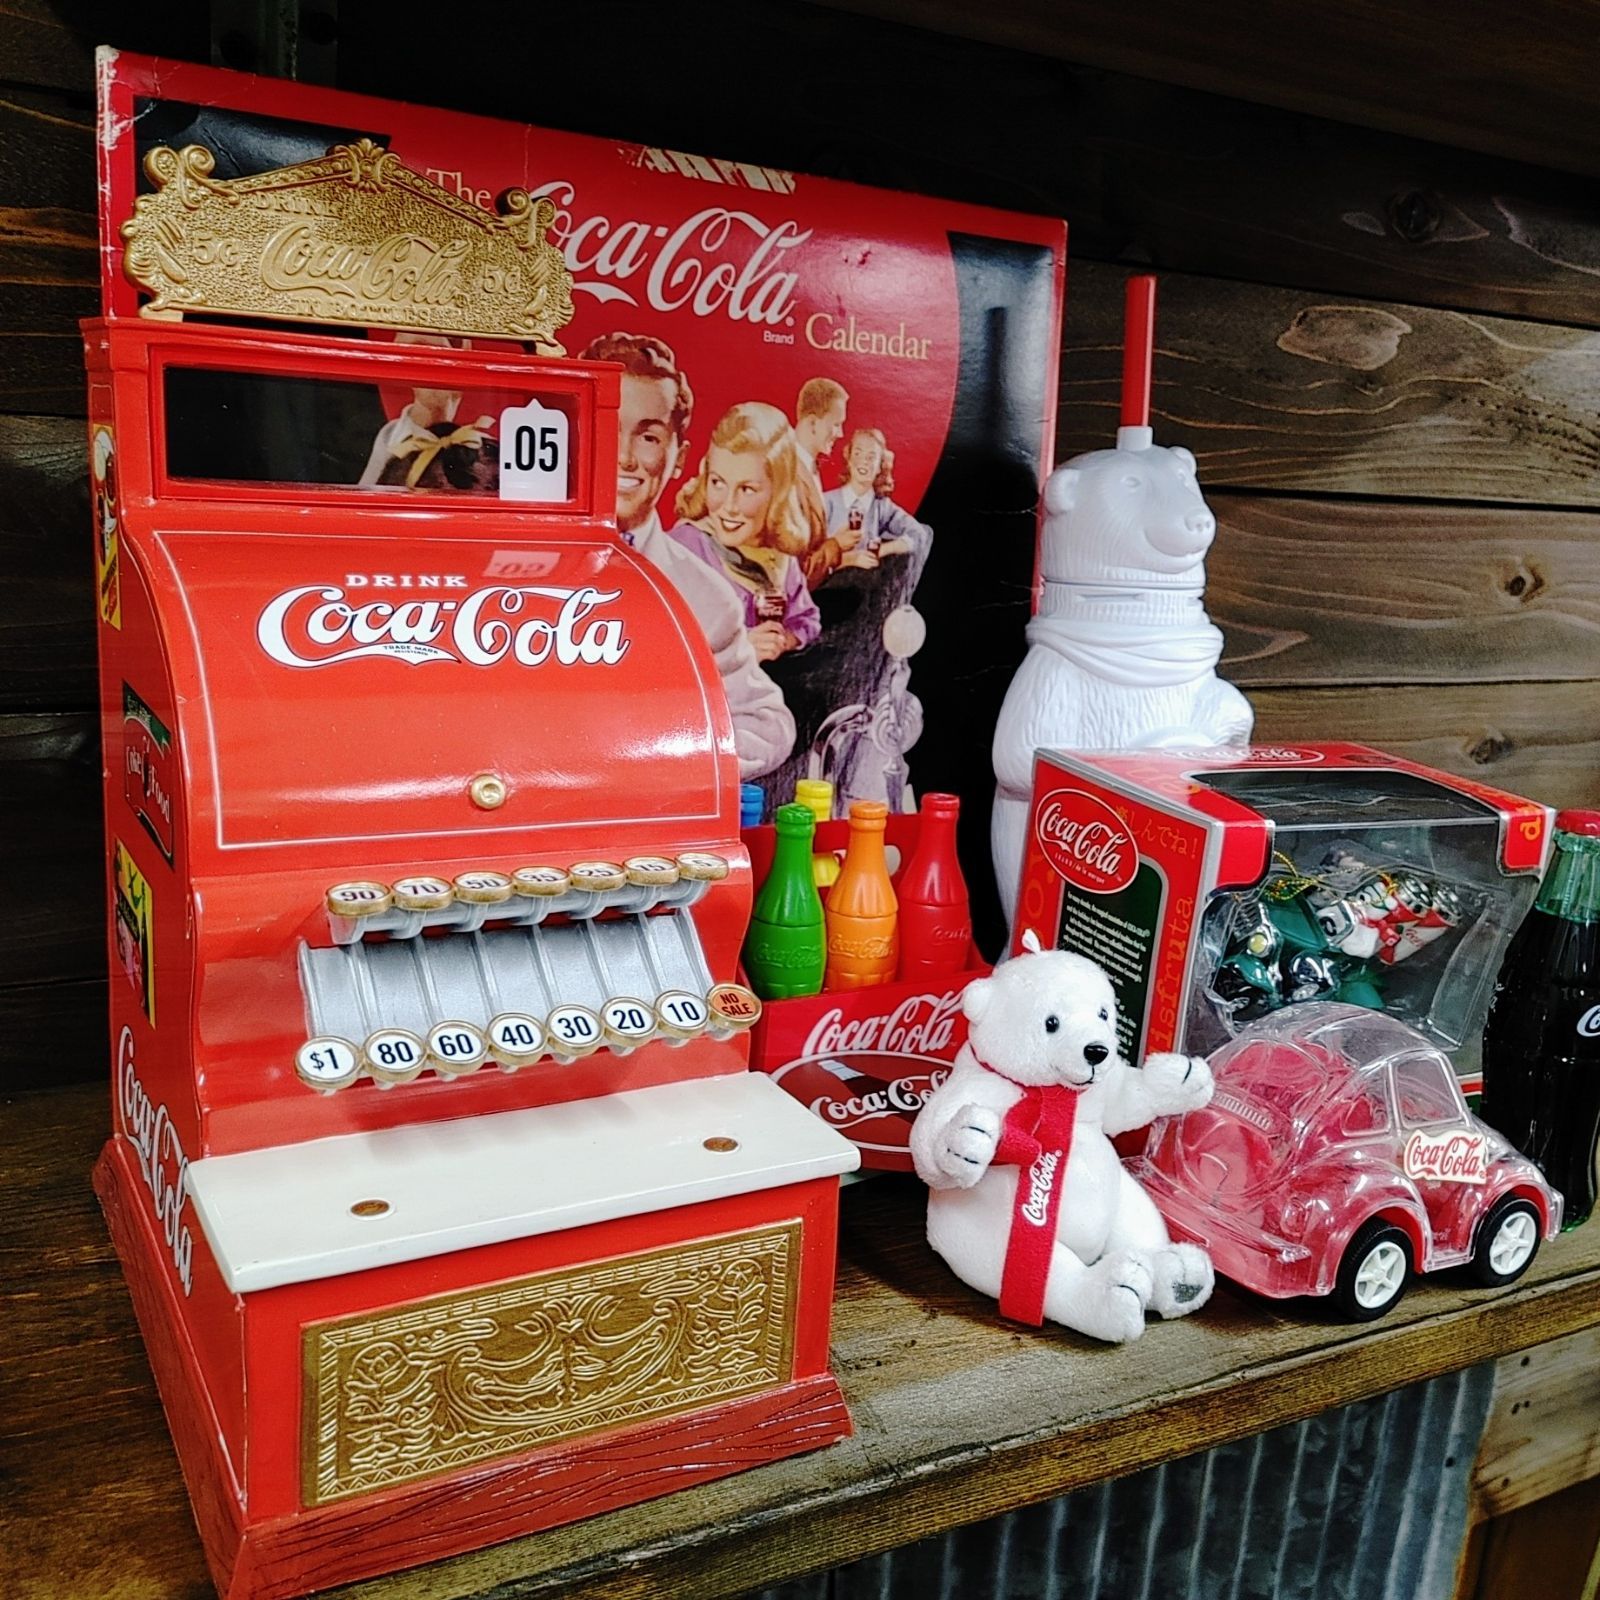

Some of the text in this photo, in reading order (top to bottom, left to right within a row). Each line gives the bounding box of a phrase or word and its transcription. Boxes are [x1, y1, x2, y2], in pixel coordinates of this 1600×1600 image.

[426, 167, 492, 212] The
[261, 220, 472, 305] Coca-Cola
[763, 312, 932, 361] Brand Calendar
[345, 574, 468, 588] DRINK
[256, 584, 632, 668] Coca-Cola
[1039, 802, 1129, 876] Coca-Cola
[340, 888, 376, 901] 90
[402, 883, 441, 895] 70
[466, 877, 500, 889] 50
[1148, 895, 1196, 1054] isfruta
[719, 992, 740, 1005] NO
[721, 1002, 753, 1017] SALE
[617, 1007, 646, 1031] 20
[667, 1000, 700, 1024] 10
[802, 990, 965, 1058] Coca-Cola
[500, 1022, 535, 1048] 40
[557, 1014, 593, 1039] 30
[377, 1039, 415, 1066] 80
[438, 1032, 475, 1057] 60
[309, 1046, 341, 1072] $1
[809, 1069, 949, 1130] Coca-Col
[117, 1025, 193, 1298] Coca-Cola
[1404, 1134, 1483, 1178] Coca-Cola
[1021, 1151, 1059, 1227] Coca-Cola
